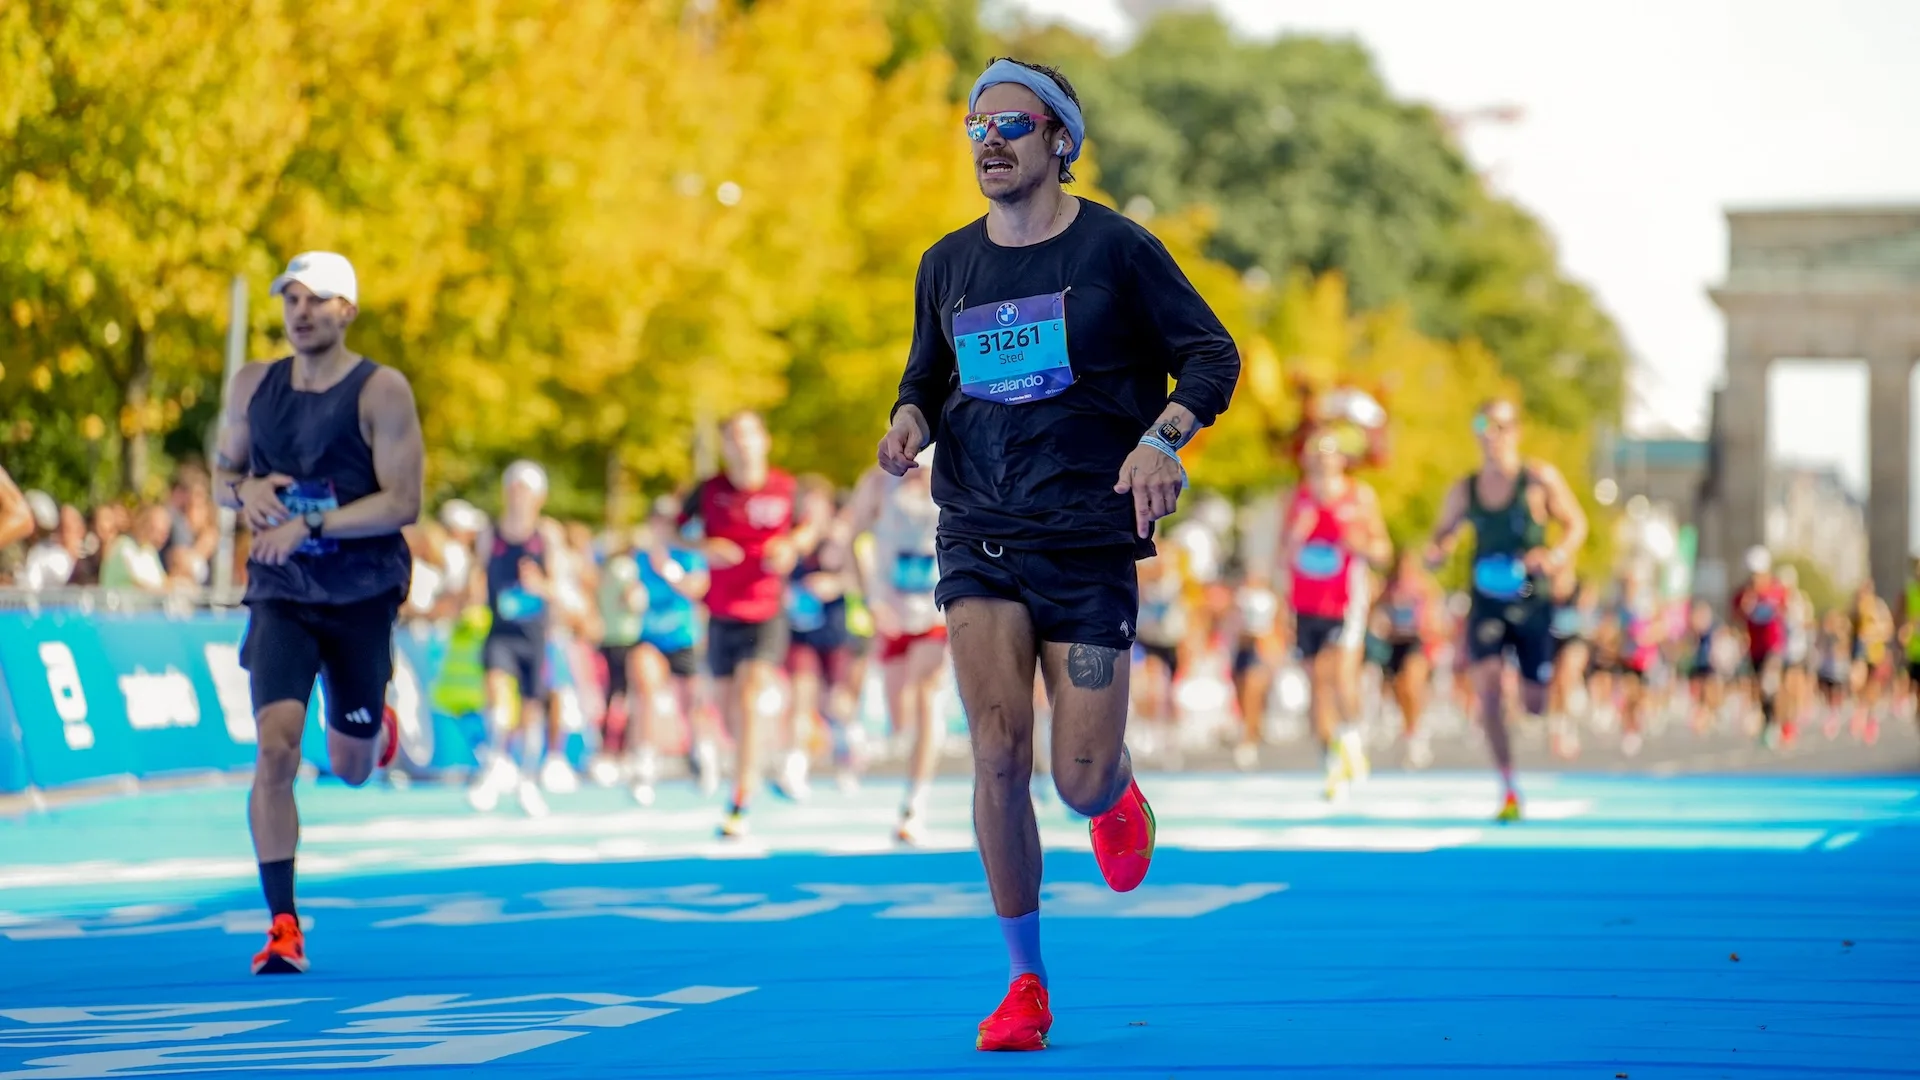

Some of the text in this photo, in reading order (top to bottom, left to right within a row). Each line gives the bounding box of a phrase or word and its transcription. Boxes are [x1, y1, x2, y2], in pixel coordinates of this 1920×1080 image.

[1054, 323, 1059, 331] C
[978, 325, 1040, 355] 31261
[999, 351, 1025, 365] Sted
[989, 374, 1044, 395] zalando
